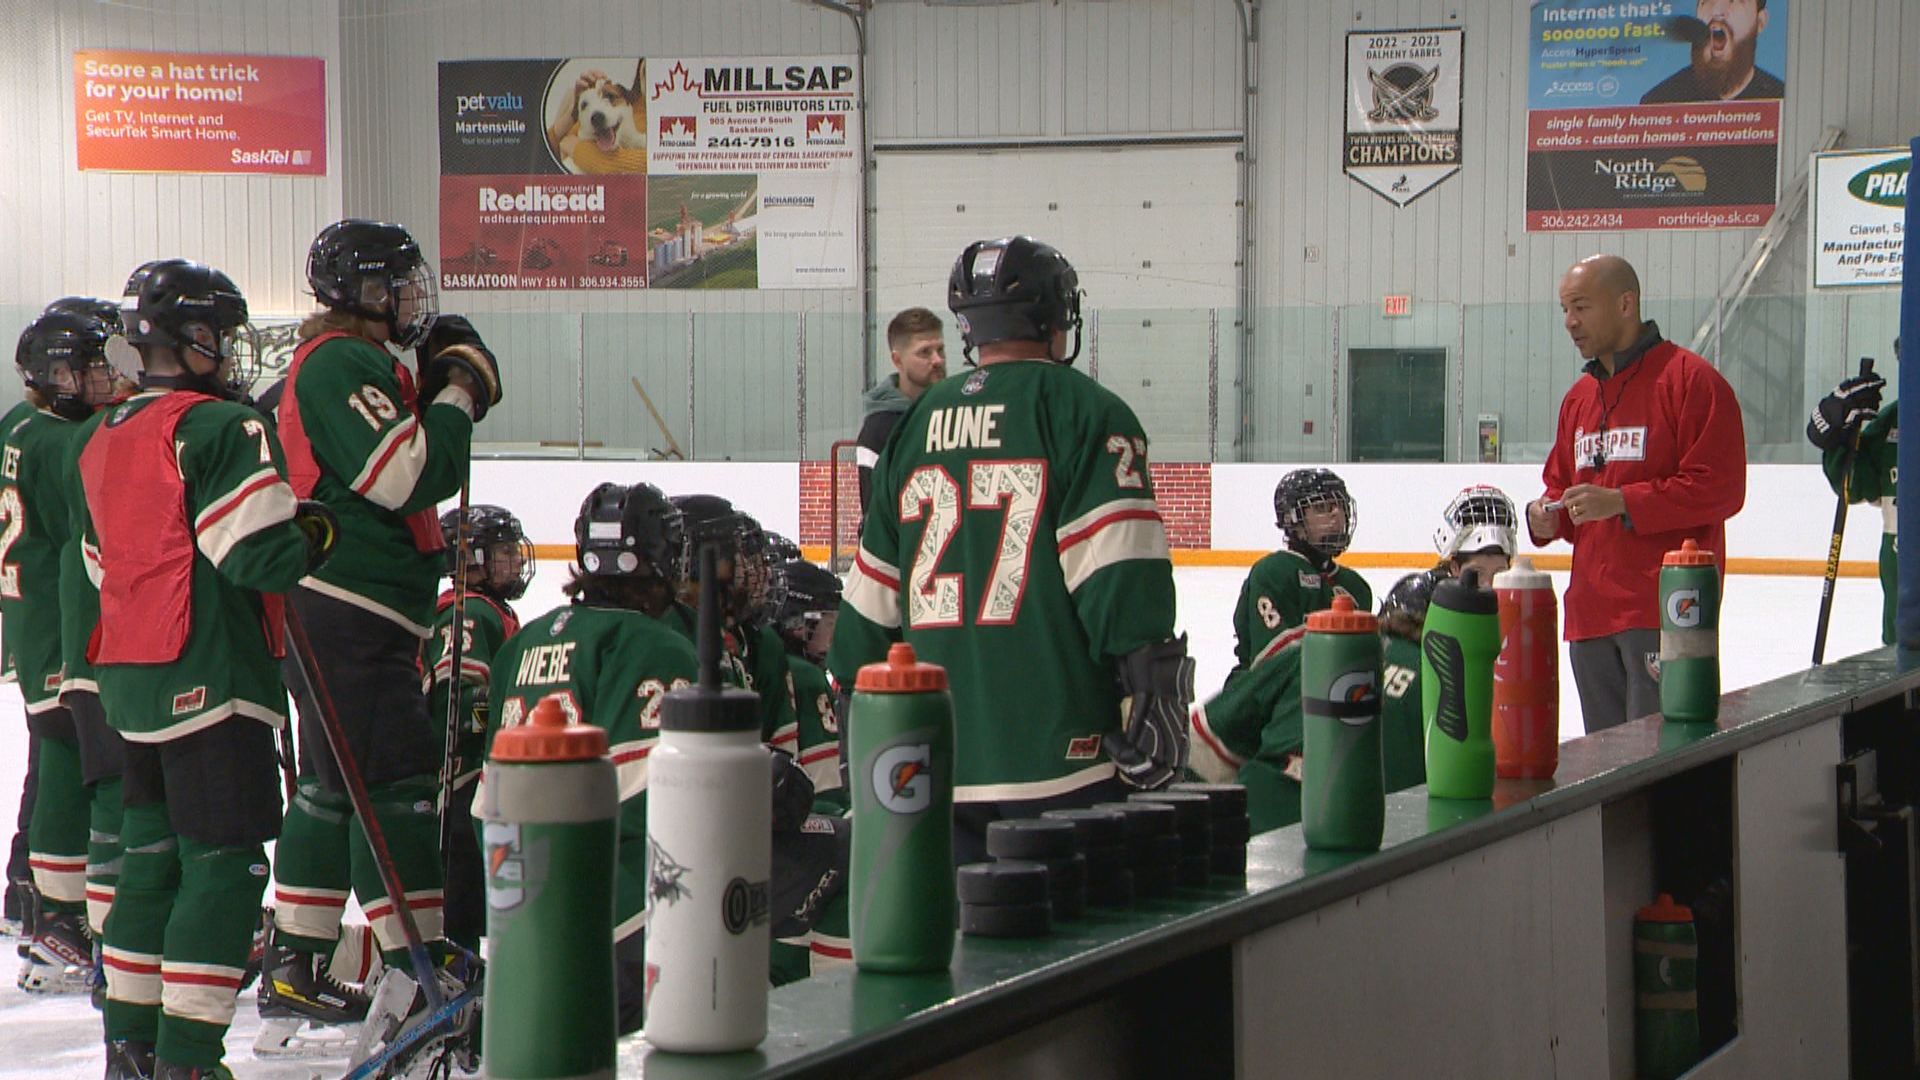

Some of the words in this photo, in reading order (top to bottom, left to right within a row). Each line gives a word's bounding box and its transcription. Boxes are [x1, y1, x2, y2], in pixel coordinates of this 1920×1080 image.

[1543, 4, 1616, 22] Internet
[1620, 2, 1672, 18] that's
[1543, 26, 1619, 41] soooooo
[1624, 22, 1665, 38] fast.
[1369, 38, 1397, 49] 2022
[1411, 36, 1440, 47] 2023
[1366, 50, 1407, 60] DALMENY
[1409, 48, 1442, 58] SABRES
[84, 60, 145, 77] Score
[150, 67, 164, 79] a
[169, 62, 205, 80] hat
[209, 64, 259, 81] trick
[704, 65, 853, 92] MILLSAP
[85, 80, 116, 98] for
[120, 84, 170, 102] your
[175, 83, 243, 101] home!
[456, 92, 485, 117] pet
[486, 92, 523, 110] valu
[703, 101, 732, 114] FUEL
[736, 99, 825, 113] DISTRIBUTORS
[828, 99, 854, 112] LTD.
[85, 110, 110, 123] Get
[113, 110, 136, 124] TV,
[140, 111, 194, 125] Internet
[198, 114, 223, 126] and
[455, 120, 526, 134] Martensville
[727, 116, 758, 124] Avenue
[769, 116, 793, 124] South
[1546, 115, 1584, 132] single
[1587, 113, 1626, 130] family
[1629, 113, 1672, 126] homes
[1683, 110, 1761, 124] townhomes
[86, 125, 147, 138] SecurTek
[151, 126, 192, 140] Smart
[196, 128, 240, 141] Home.
[729, 126, 774, 134] Saskatoon
[1536, 134, 1582, 146] condos
[1592, 133, 1639, 145] custom
[1642, 131, 1687, 144] homes
[1696, 127, 1774, 141] renovations
[708, 136, 796, 148] 244-7916
[231, 148, 289, 165] SaskTel
[653, 152, 686, 160] SUPPLYING
[688, 152, 699, 160] THE
[701, 152, 739, 160] PETROLEUM
[741, 151, 762, 159] NEEDS
[763, 151, 771, 159] OF
[773, 151, 800, 159] CENTRAL
[802, 151, 853, 159] SASKATCHEWAN
[1350, 144, 1456, 163] CHAMPIONS
[786, 161, 798, 169] AND
[1595, 158, 1654, 174] North
[542, 184, 595, 194] EQUIPMENT
[1615, 173, 1676, 192] Ridge
[479, 186, 605, 212] Redhead
[764, 195, 815, 204] RICHARDSON
[479, 214, 605, 225] redheadequipment.ca
[1541, 214, 1623, 228] 306.242.2434
[1658, 211, 1760, 227] northridge.sk.ca
[1850, 223, 1890, 236] Clavet,
[1838, 253, 1861, 265] And
[443, 274, 517, 288] SASKATOON
[521, 277, 543, 287] HWY
[546, 277, 557, 287] 16
[559, 277, 567, 287] N
[579, 276, 645, 288] 306.934.3555
[1385, 296, 1407, 315] EXIT
[347, 383, 398, 433] 19
[926, 404, 1006, 454] AUNE
[241, 418, 273, 465] 7
[900, 458, 1048, 631] 27
[1257, 595, 1282, 630] 8
[516, 641, 577, 688] WIEBE
[873, 743, 932, 815] G
[44, 935, 88, 966] CCM
